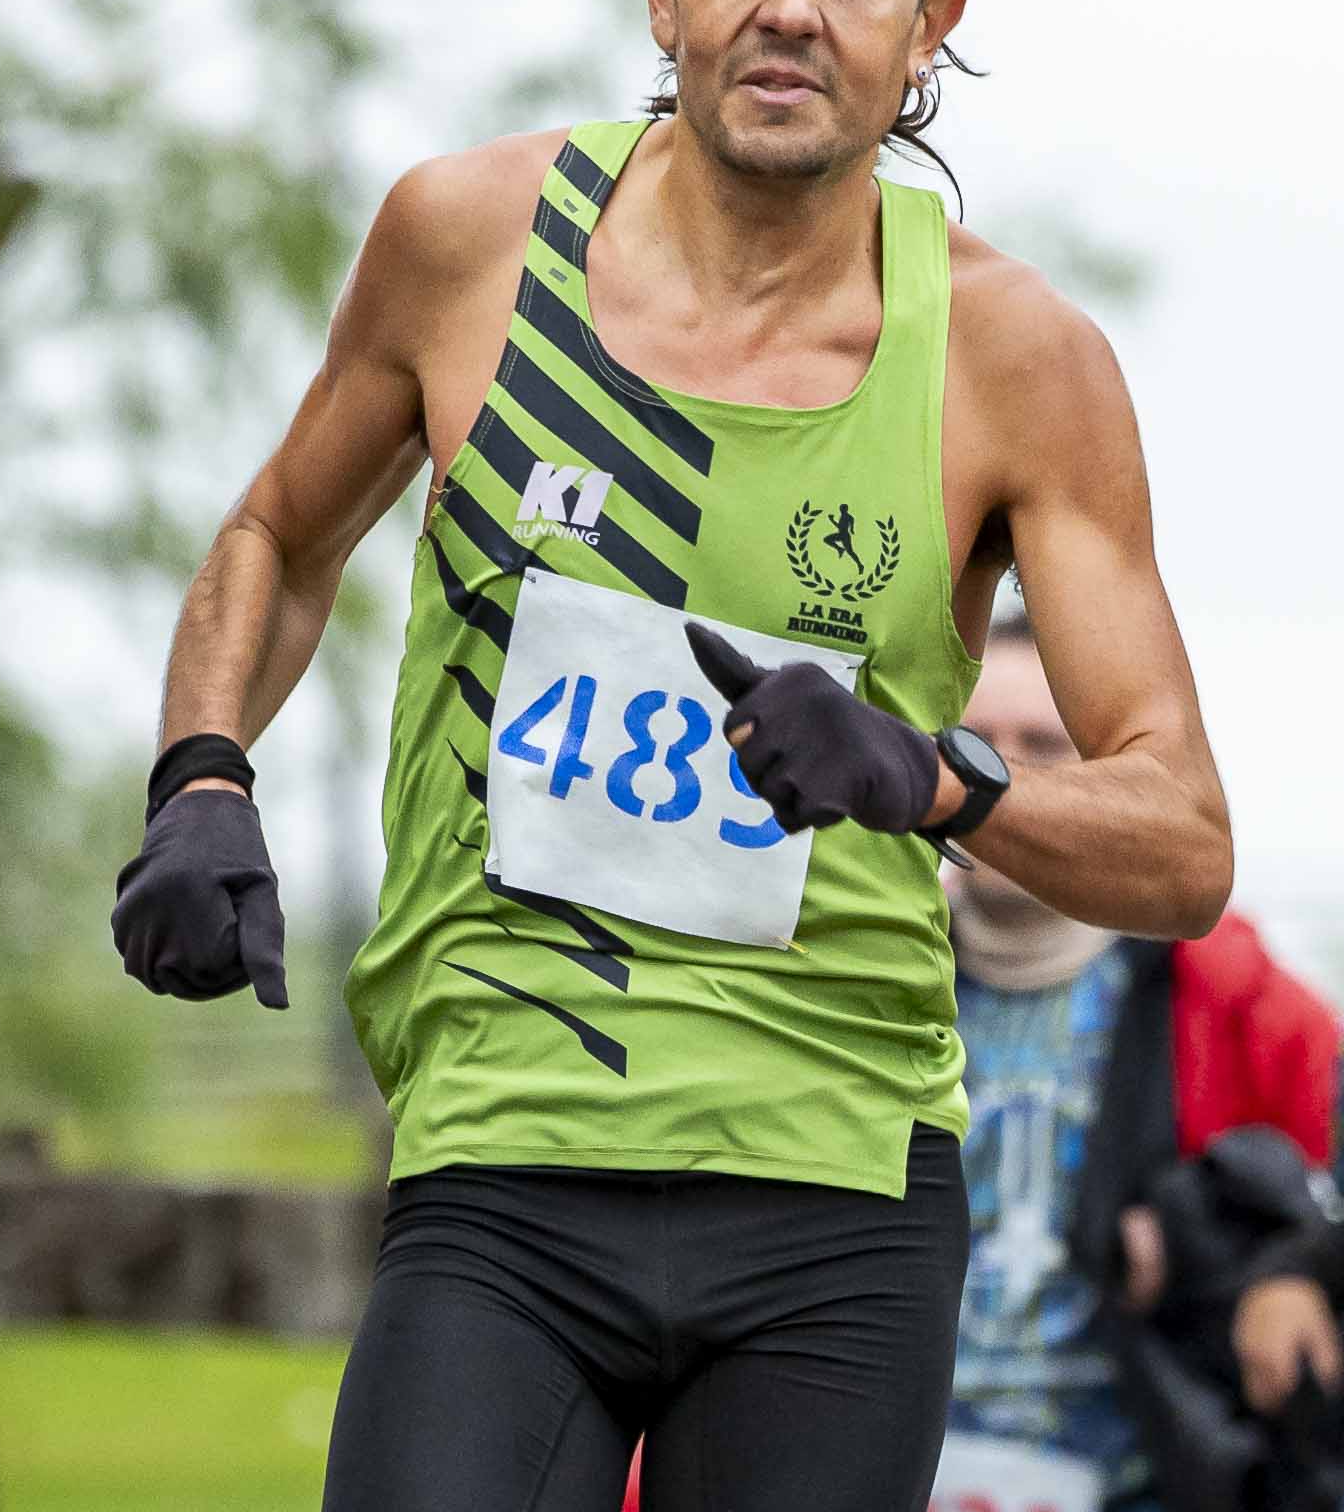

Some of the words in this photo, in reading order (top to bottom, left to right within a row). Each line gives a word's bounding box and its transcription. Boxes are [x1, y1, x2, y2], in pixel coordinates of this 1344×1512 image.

[516, 460, 614, 528] K1
[512, 521, 601, 546] RUNNING
[798, 601, 824, 619] LA
